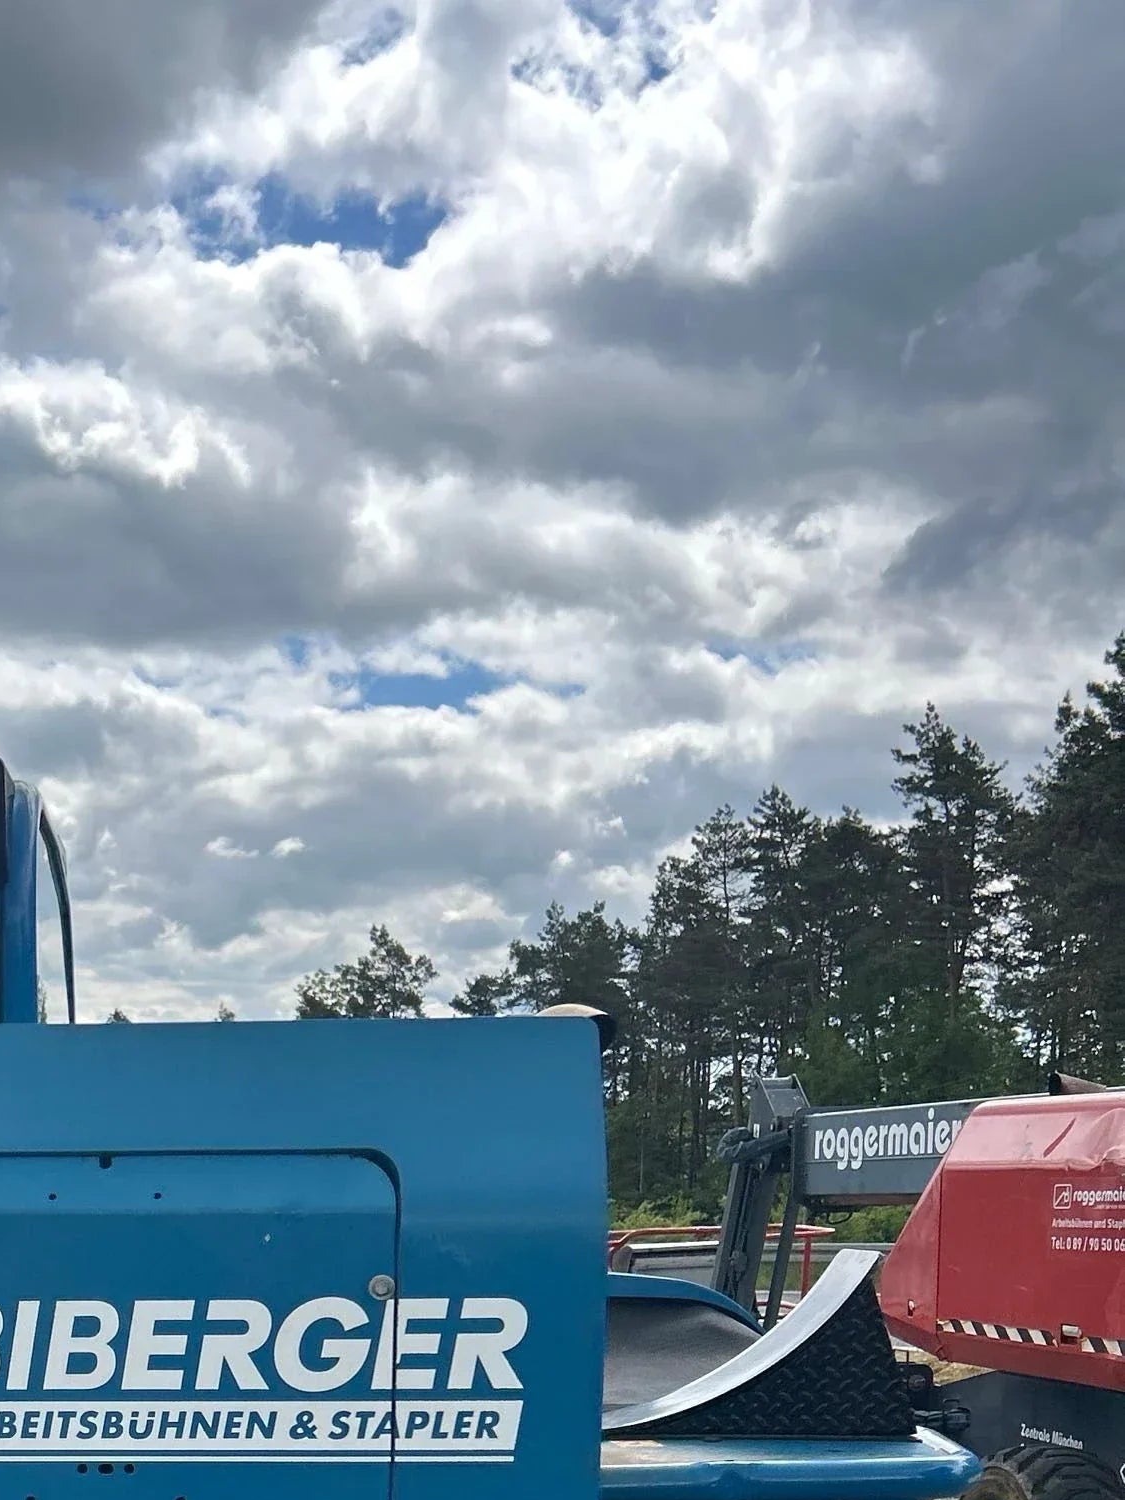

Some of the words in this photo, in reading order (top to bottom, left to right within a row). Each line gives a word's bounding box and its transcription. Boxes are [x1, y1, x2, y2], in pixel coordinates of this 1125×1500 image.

[1101, 1238, 1112, 1251] 50
[288, 1410, 318, 1440] &
[328, 1410, 500, 1440] STAPLER
[1020, 1423, 1051, 1443] Zentrale
